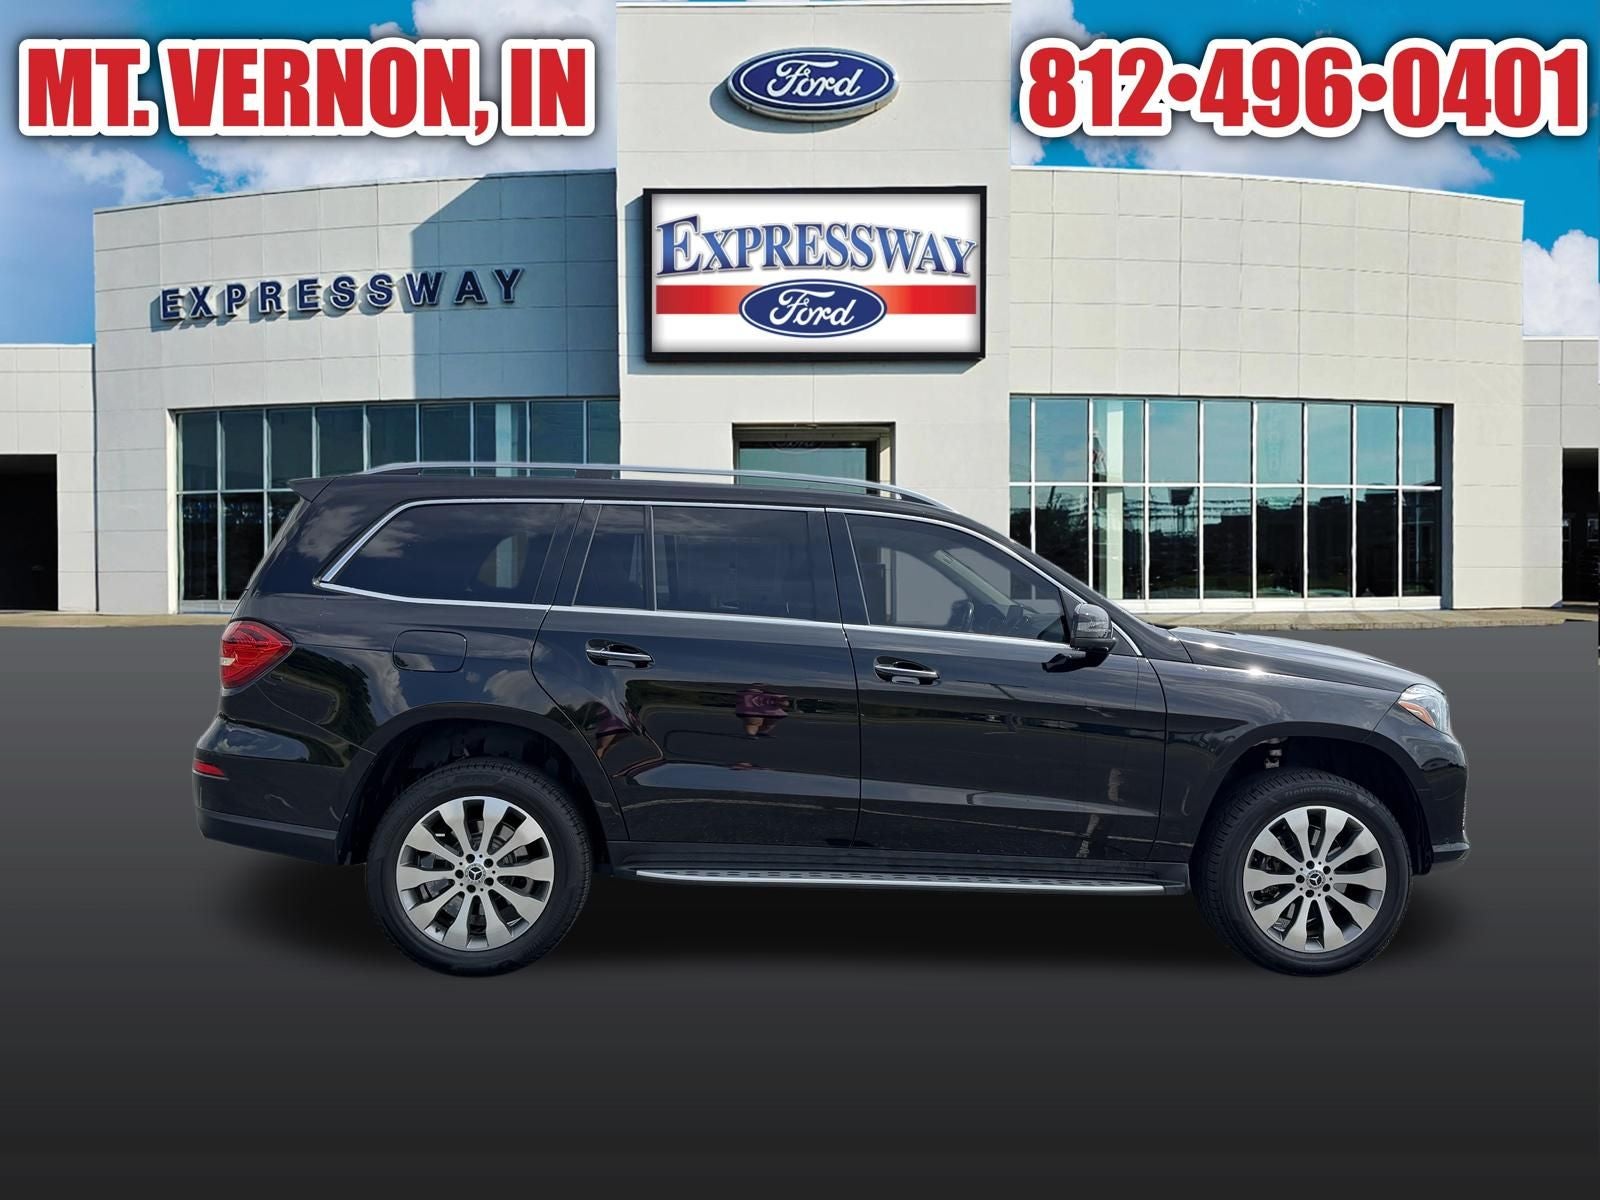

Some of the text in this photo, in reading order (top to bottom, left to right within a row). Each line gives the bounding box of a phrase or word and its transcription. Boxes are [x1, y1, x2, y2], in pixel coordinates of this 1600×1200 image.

[766, 59, 862, 98] Ford
[160, 267, 525, 321] EXPRESSWAY
[768, 287, 857, 327] Ford
